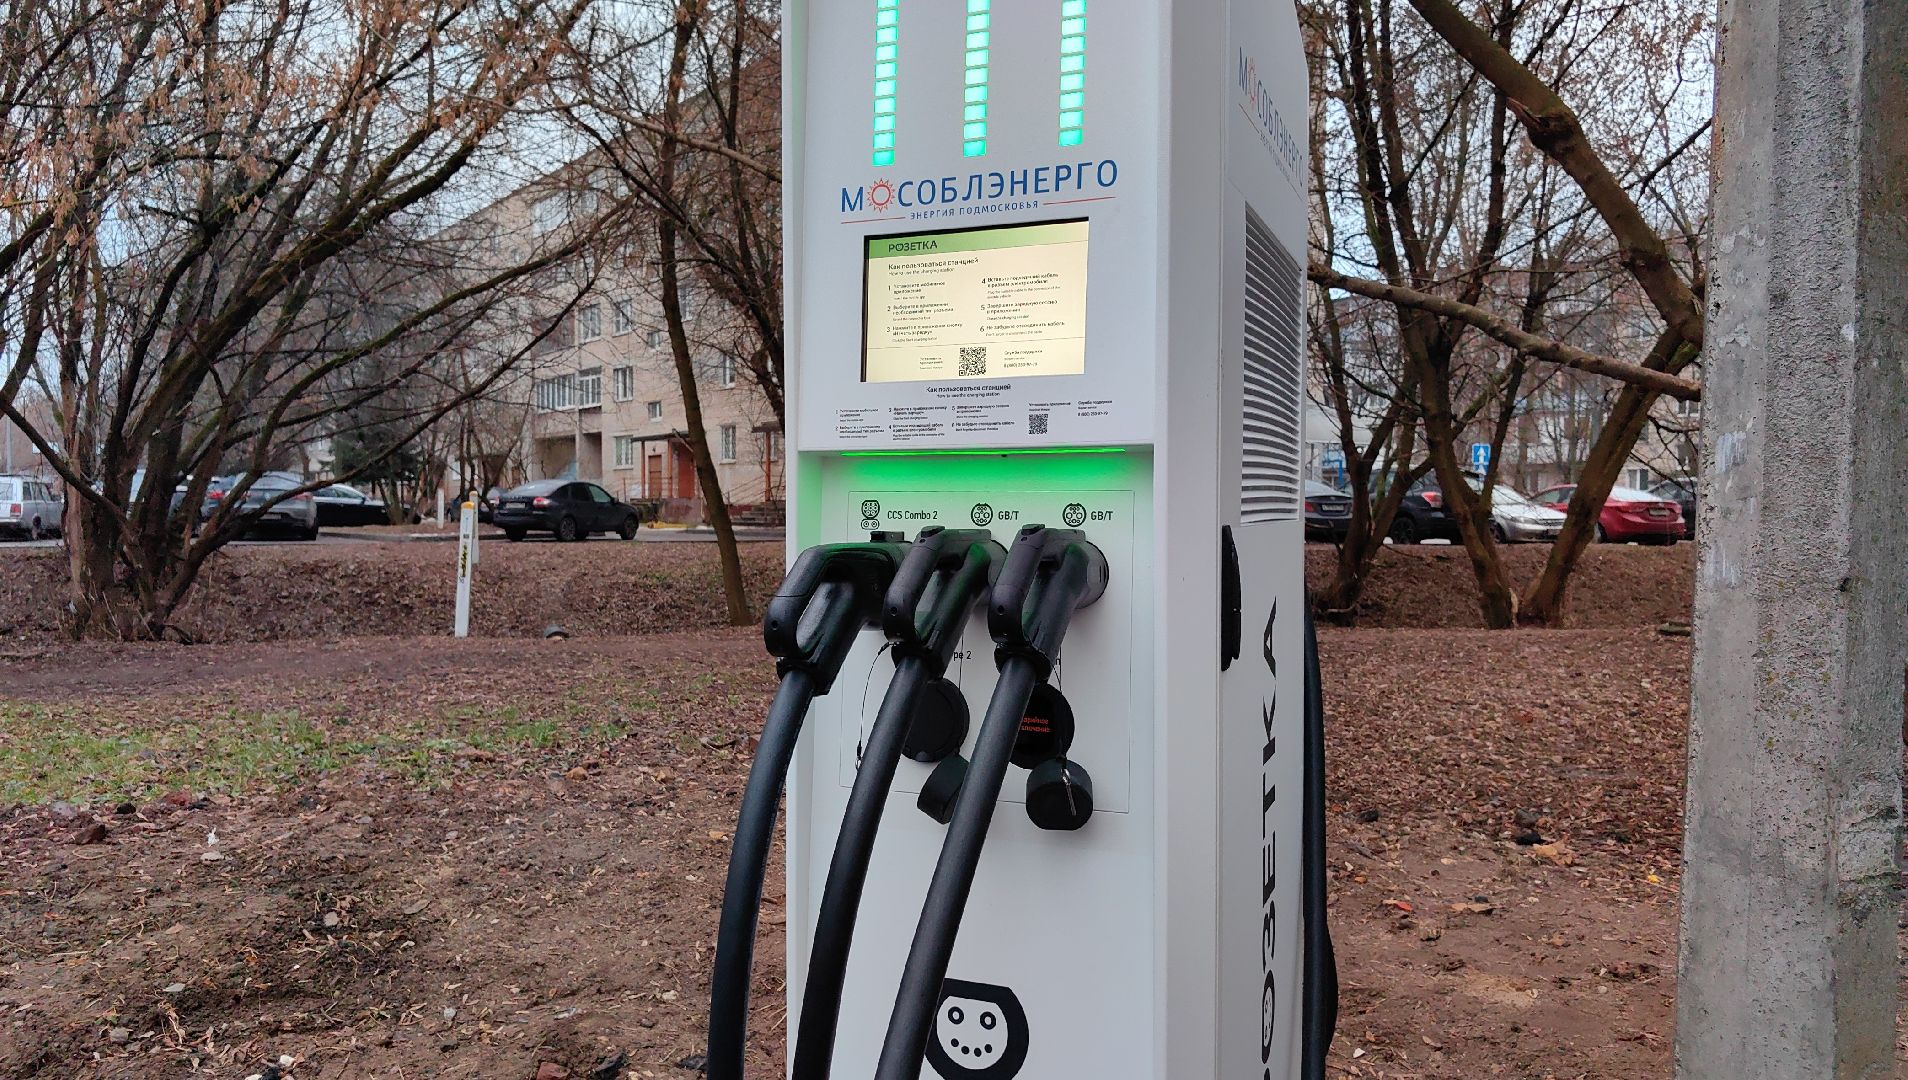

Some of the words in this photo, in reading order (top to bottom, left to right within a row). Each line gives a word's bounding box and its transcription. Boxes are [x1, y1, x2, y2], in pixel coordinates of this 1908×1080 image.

[841, 159, 1118, 213] МОСОБЛЭНЕРГО
[910, 207, 955, 220] ЭНЕРГИЯ
[959, 200, 1039, 216] ПОДМОСКОВЬЯ
[888, 240, 938, 252] РОЗЕТКА
[887, 510, 903, 520] CCS
[904, 510, 931, 520] Combo
[932, 510, 938, 520] 2
[998, 511, 1020, 521] GB/T
[1090, 511, 1114, 521] GB/T
[953, 651, 964, 661] pe
[966, 650, 972, 660] 2
[1261, 595, 1276, 1080] ОЗЕТКА
